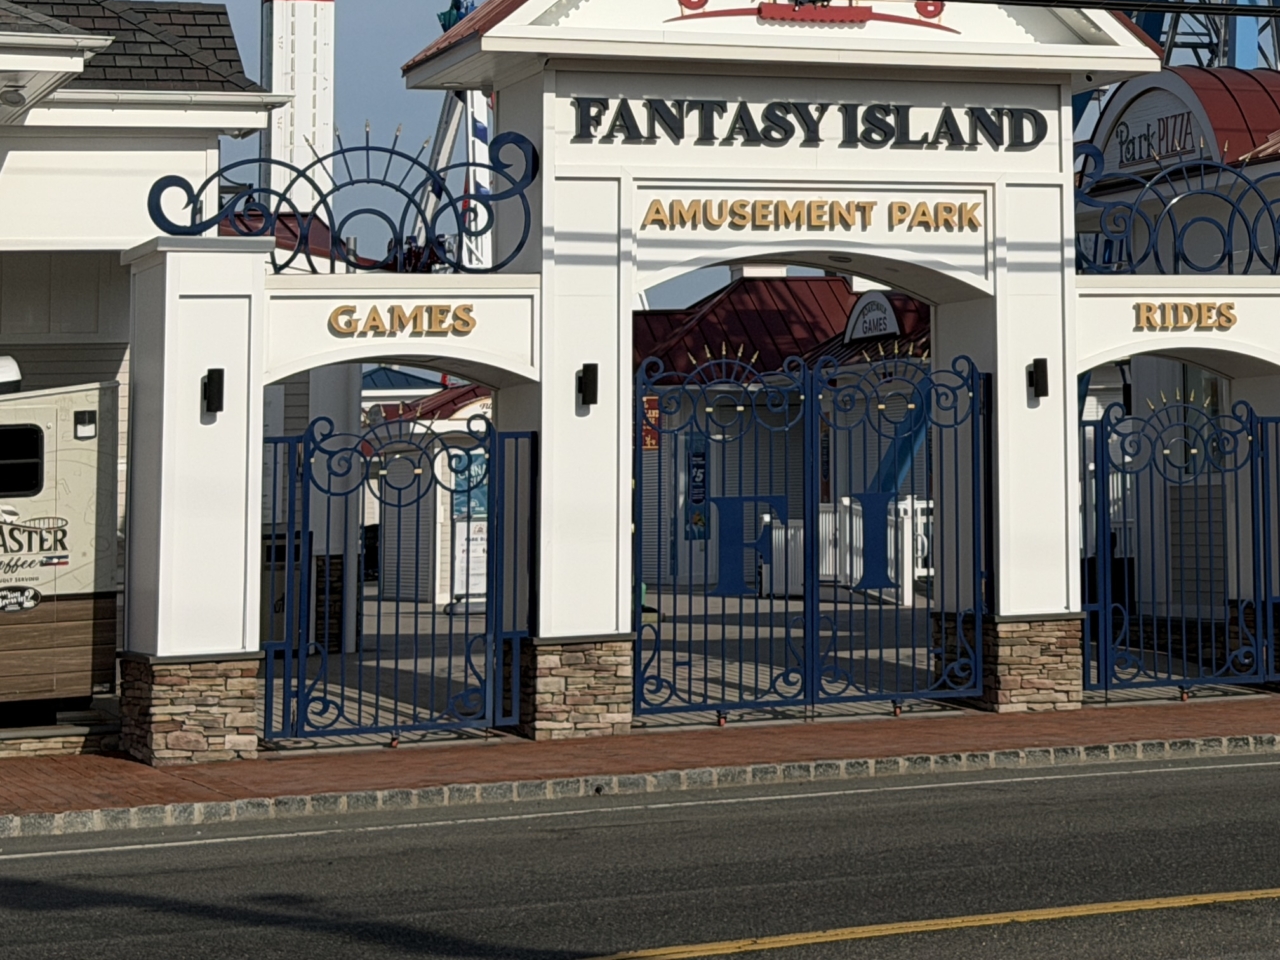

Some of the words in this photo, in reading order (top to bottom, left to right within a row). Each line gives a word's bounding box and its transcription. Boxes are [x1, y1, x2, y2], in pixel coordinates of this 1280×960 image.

[571, 97, 829, 147] FANTASY
[837, 102, 1048, 150] ISLAND
[1115, 121, 1157, 163] Park
[1156, 110, 1195, 155] PIZZA
[640, 198, 877, 231] AMUSEMENT
[887, 200, 982, 232] PARK
[329, 304, 477, 336] GAMES
[862, 316, 887, 335] GAMES
[1133, 302, 1238, 330] RIDES
